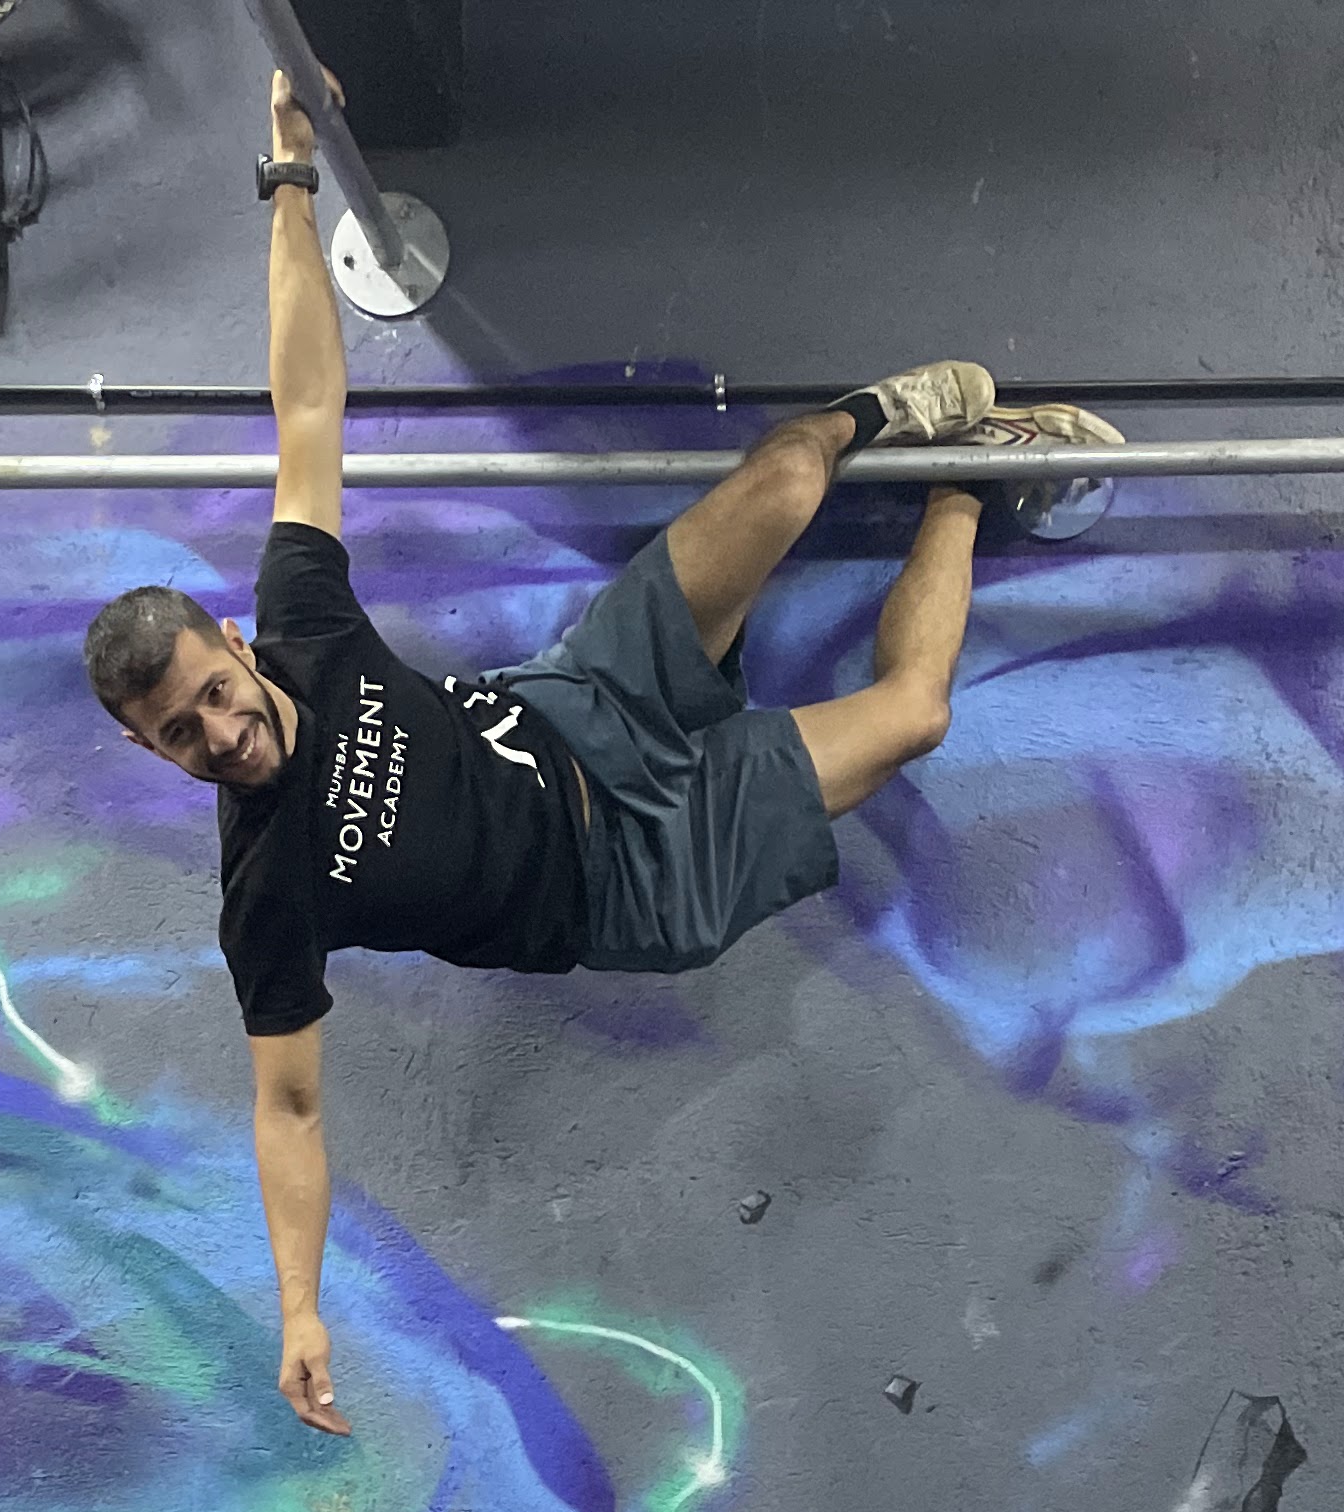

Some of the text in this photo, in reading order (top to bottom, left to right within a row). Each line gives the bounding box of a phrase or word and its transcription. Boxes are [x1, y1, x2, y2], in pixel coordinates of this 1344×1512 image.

[325, 733, 349, 808] MUMBAI
[329, 675, 384, 883] MOVEMENT
[377, 726, 409, 847] ACADEMY
